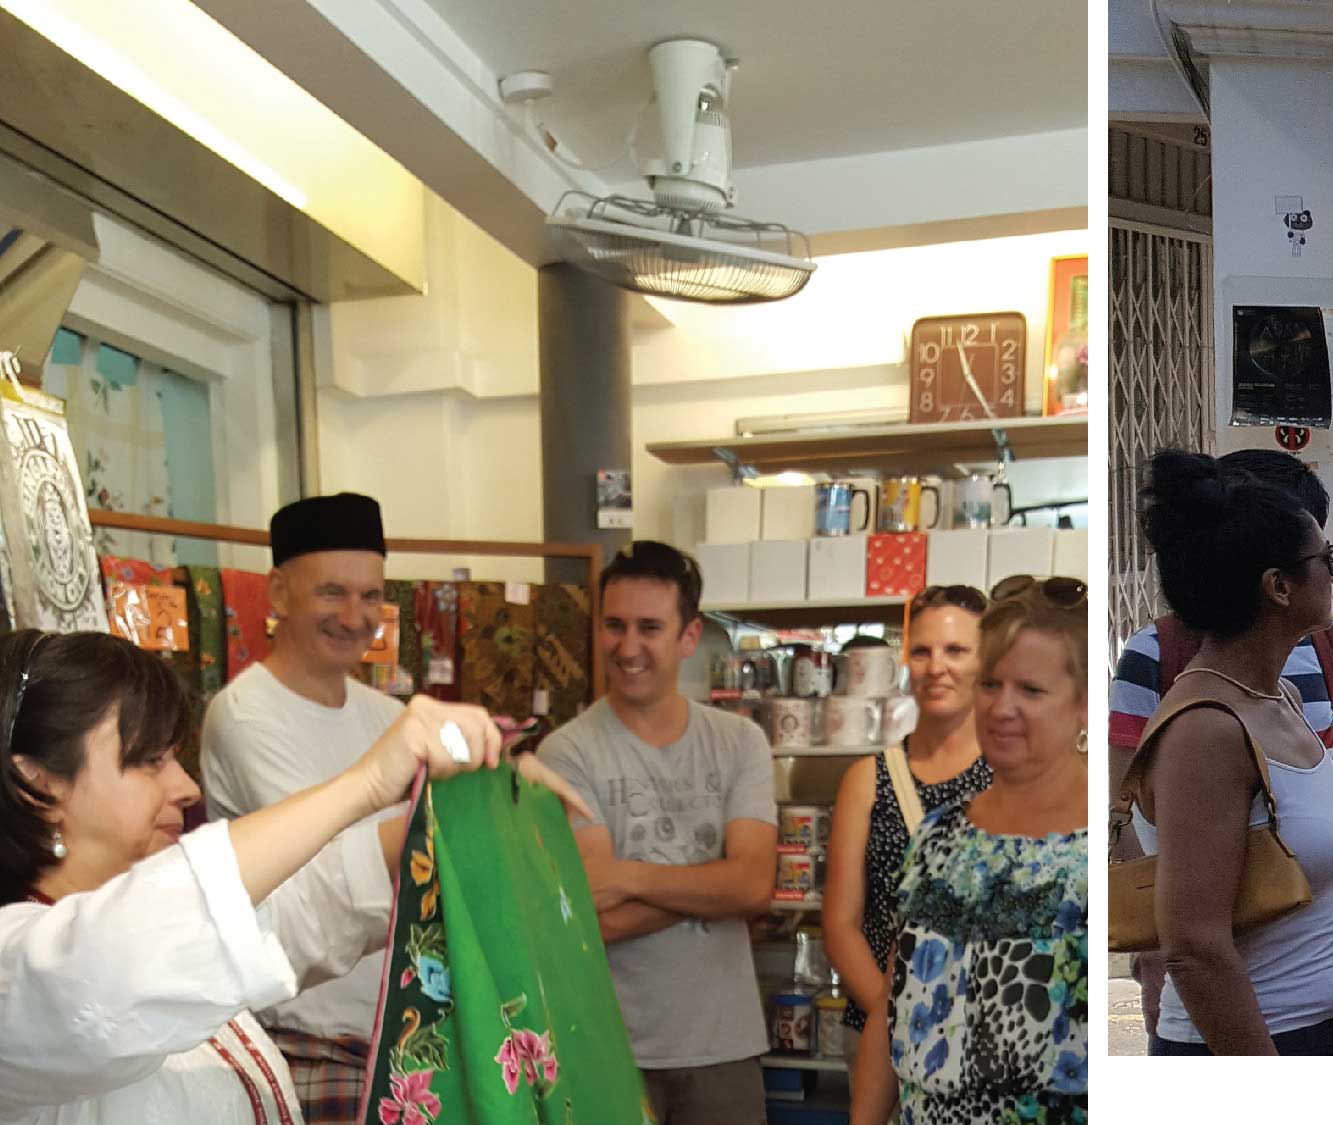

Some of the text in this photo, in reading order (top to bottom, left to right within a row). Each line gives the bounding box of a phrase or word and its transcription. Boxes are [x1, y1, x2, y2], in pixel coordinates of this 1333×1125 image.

[940, 327, 952, 345] 11
[961, 325, 980, 345] 12
[919, 342, 940, 364] 10
[1001, 340, 1017, 360] 2
[920, 368, 935, 387] 9
[1001, 364, 1015, 384] 3
[919, 392, 933, 413] 8
[1000, 389, 1014, 408] 4
